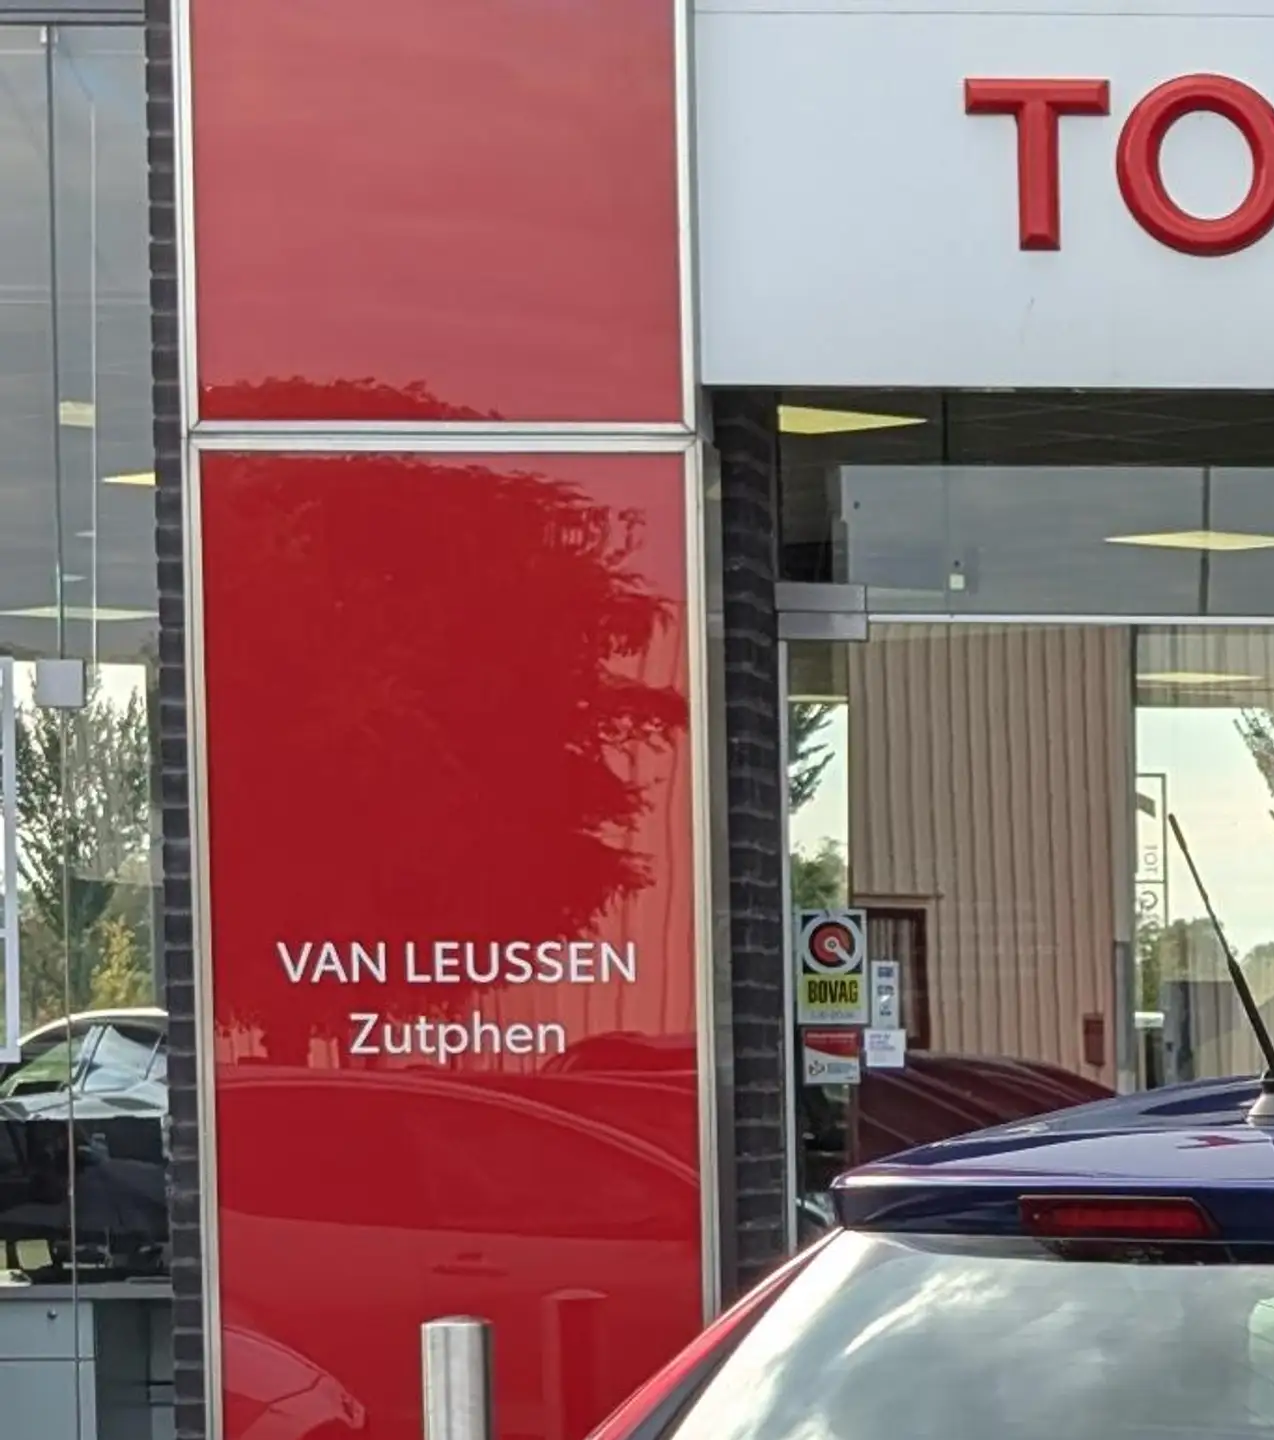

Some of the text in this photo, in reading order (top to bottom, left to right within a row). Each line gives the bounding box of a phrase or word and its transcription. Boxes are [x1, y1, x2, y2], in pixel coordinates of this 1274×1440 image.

[277, 941, 637, 983] VAN LEUSSEN
[808, 980, 859, 1003] BOVAG
[350, 1010, 566, 1064] Zutphen
